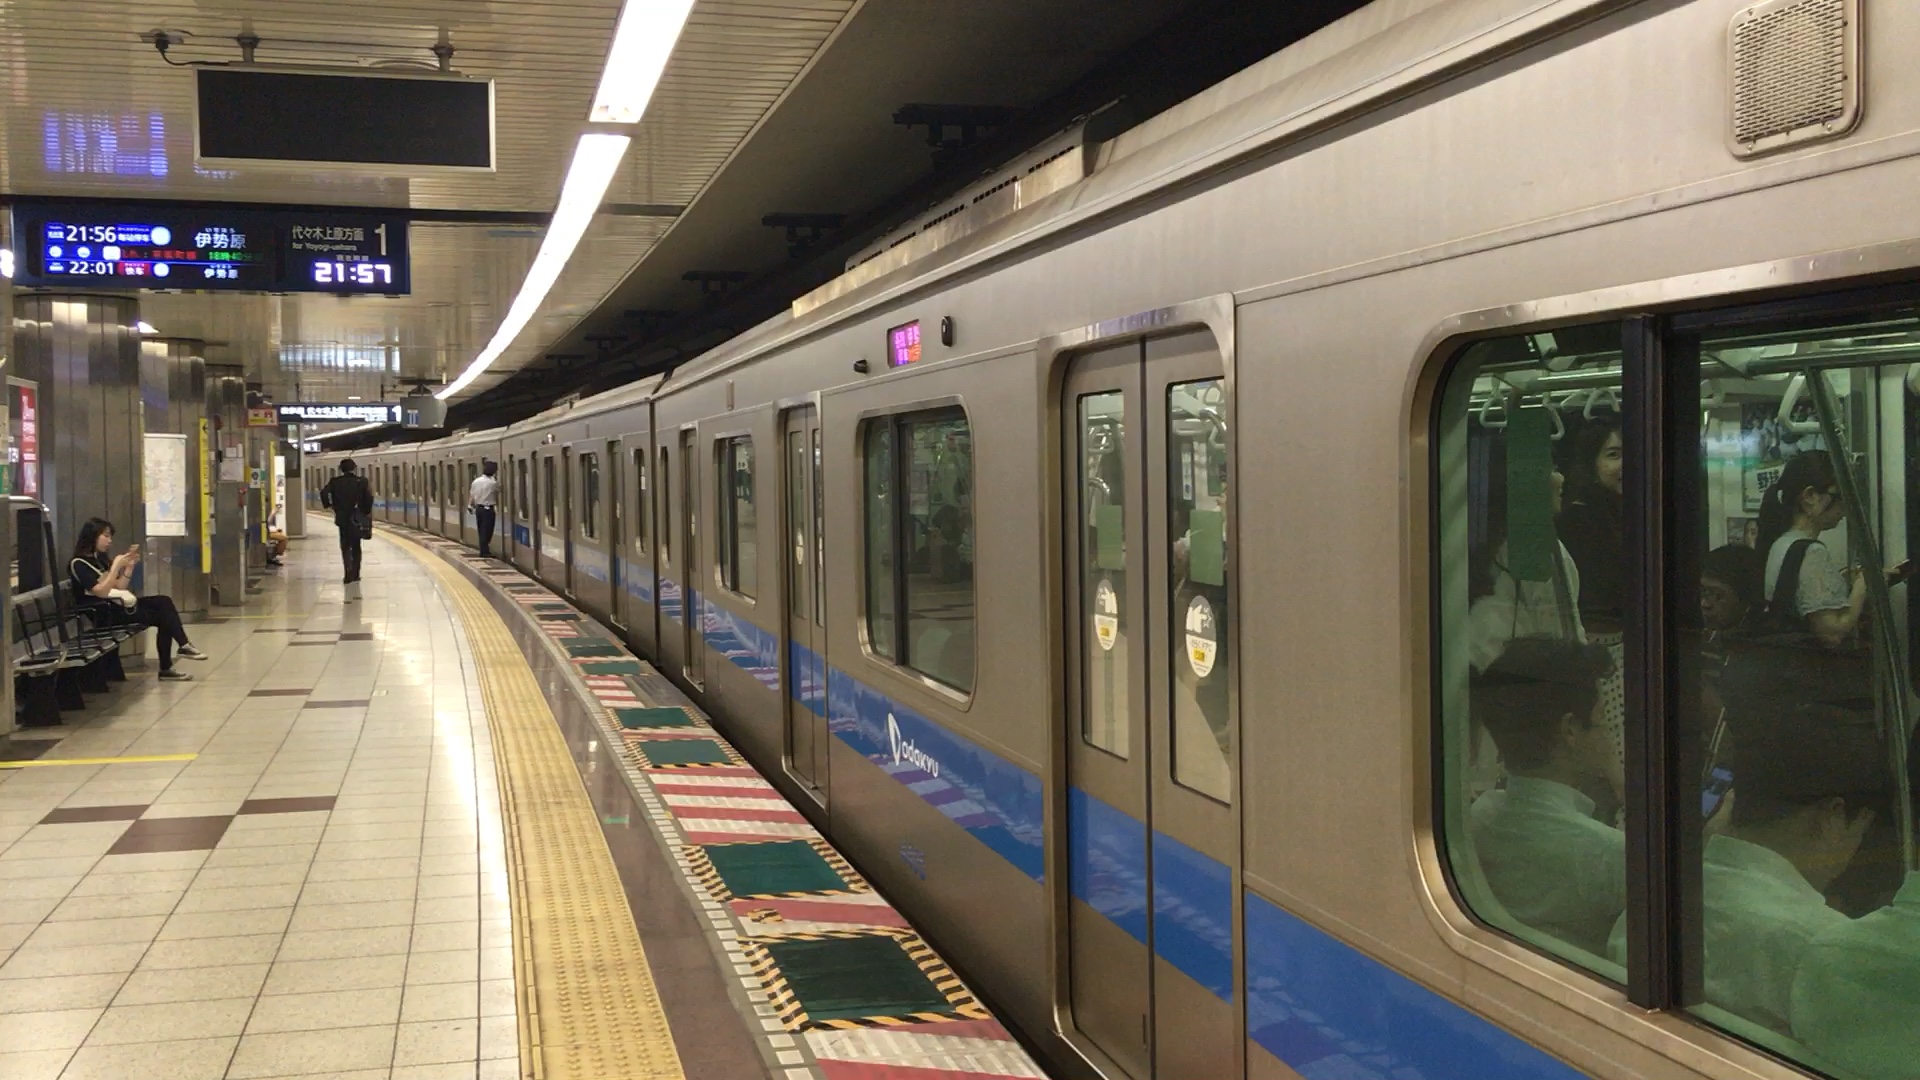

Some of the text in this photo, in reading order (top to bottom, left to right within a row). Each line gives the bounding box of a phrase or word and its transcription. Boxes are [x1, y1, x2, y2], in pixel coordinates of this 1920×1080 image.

[66, 225, 116, 242] 21:56
[292, 226, 364, 241] 代々木上原方面
[374, 223, 386, 256] 1
[292, 242, 304, 250] for
[69, 261, 114, 275] 22:01
[314, 262, 391, 284] 21:57
[901, 739, 940, 778] odakyu
